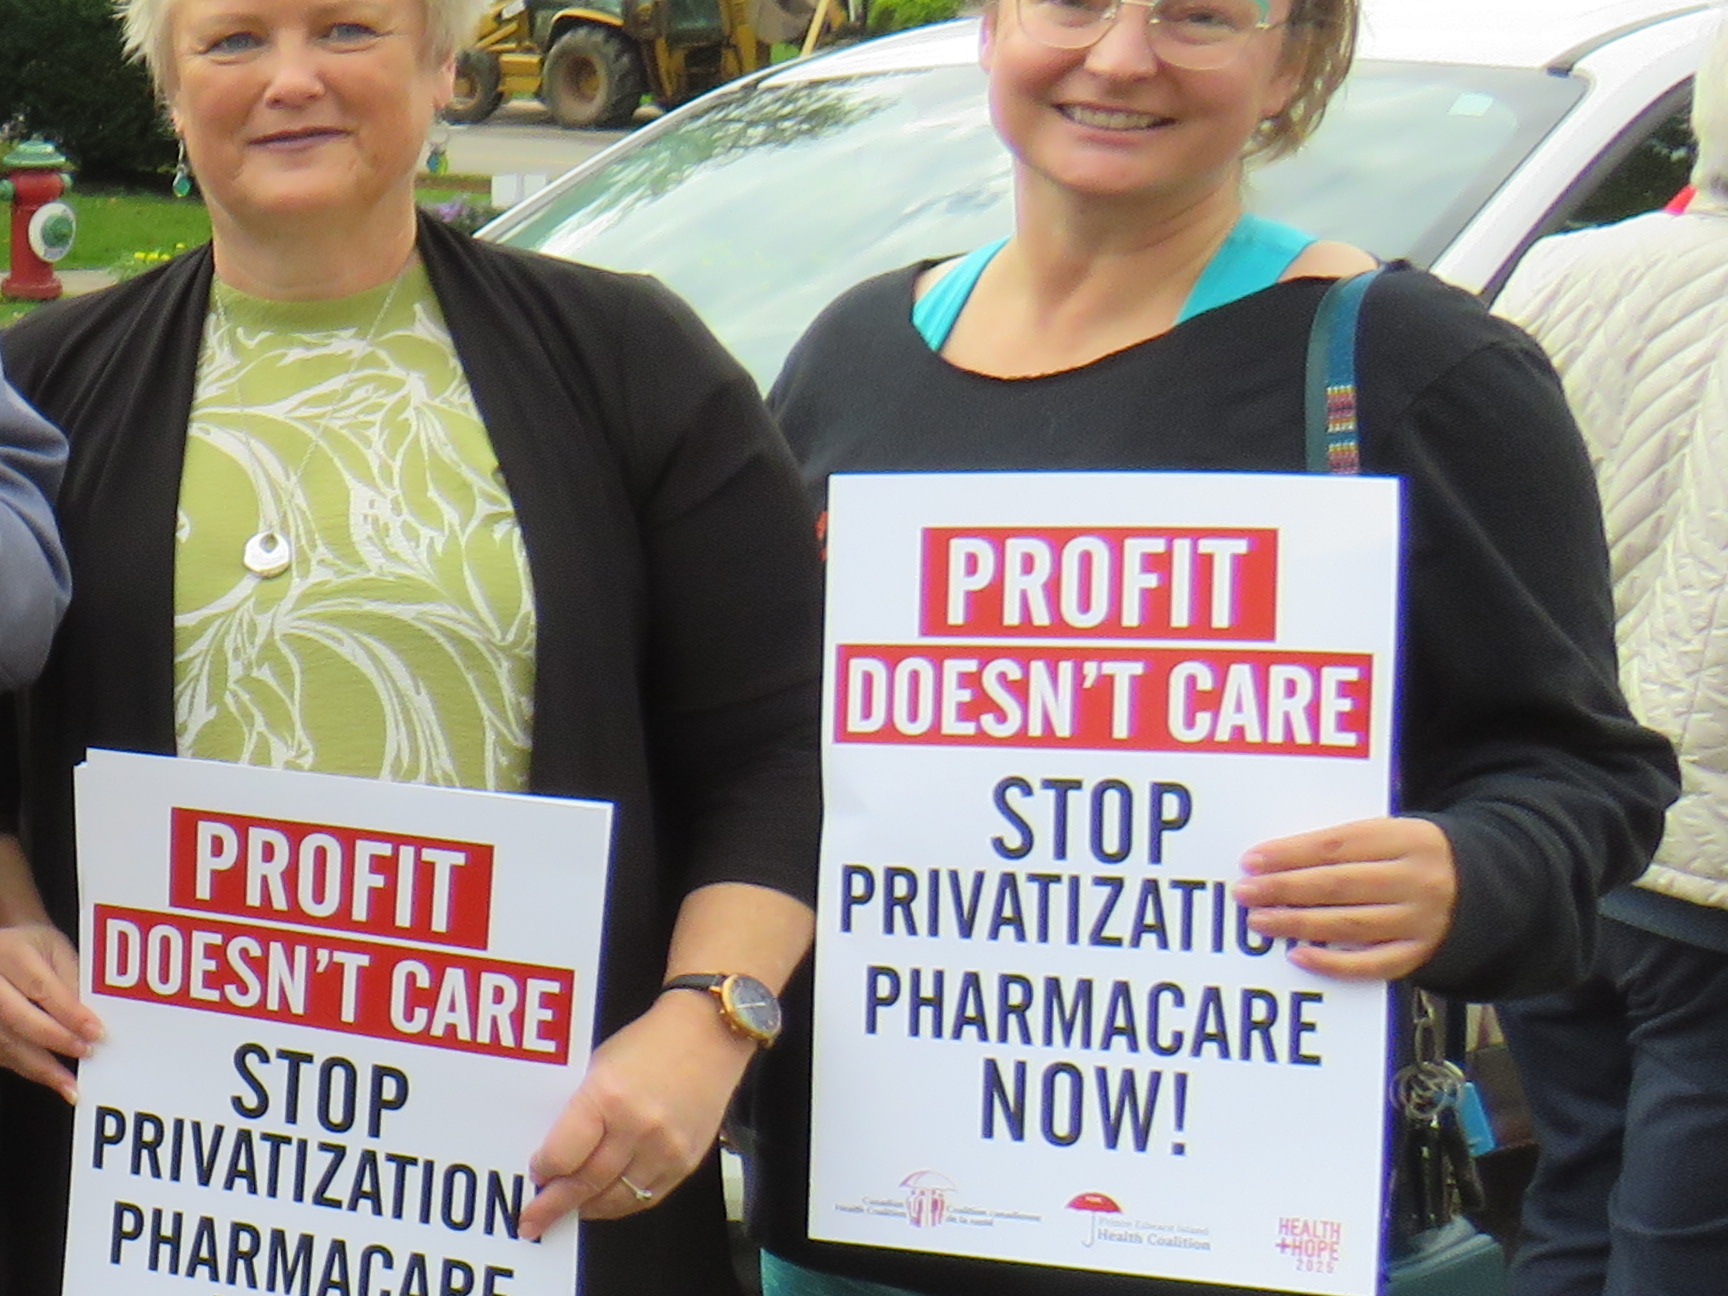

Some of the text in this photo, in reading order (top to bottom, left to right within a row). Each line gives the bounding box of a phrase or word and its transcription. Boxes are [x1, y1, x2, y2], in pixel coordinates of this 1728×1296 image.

[947, 535, 1249, 630] PROFIT
[845, 656, 1361, 748] DOESN'T CARE
[991, 776, 1193, 866] STOP
[195, 820, 466, 934] PROFIT
[104, 917, 560, 1053] DOESN'T CARE
[865, 964, 1324, 1066] PHARMACARE
[230, 1042, 409, 1139] STOP
[980, 1057, 1189, 1157] NOW!
[1097, 1228, 1211, 1251] Health Coalition
[1279, 1217, 1341, 1241] HEALTH
